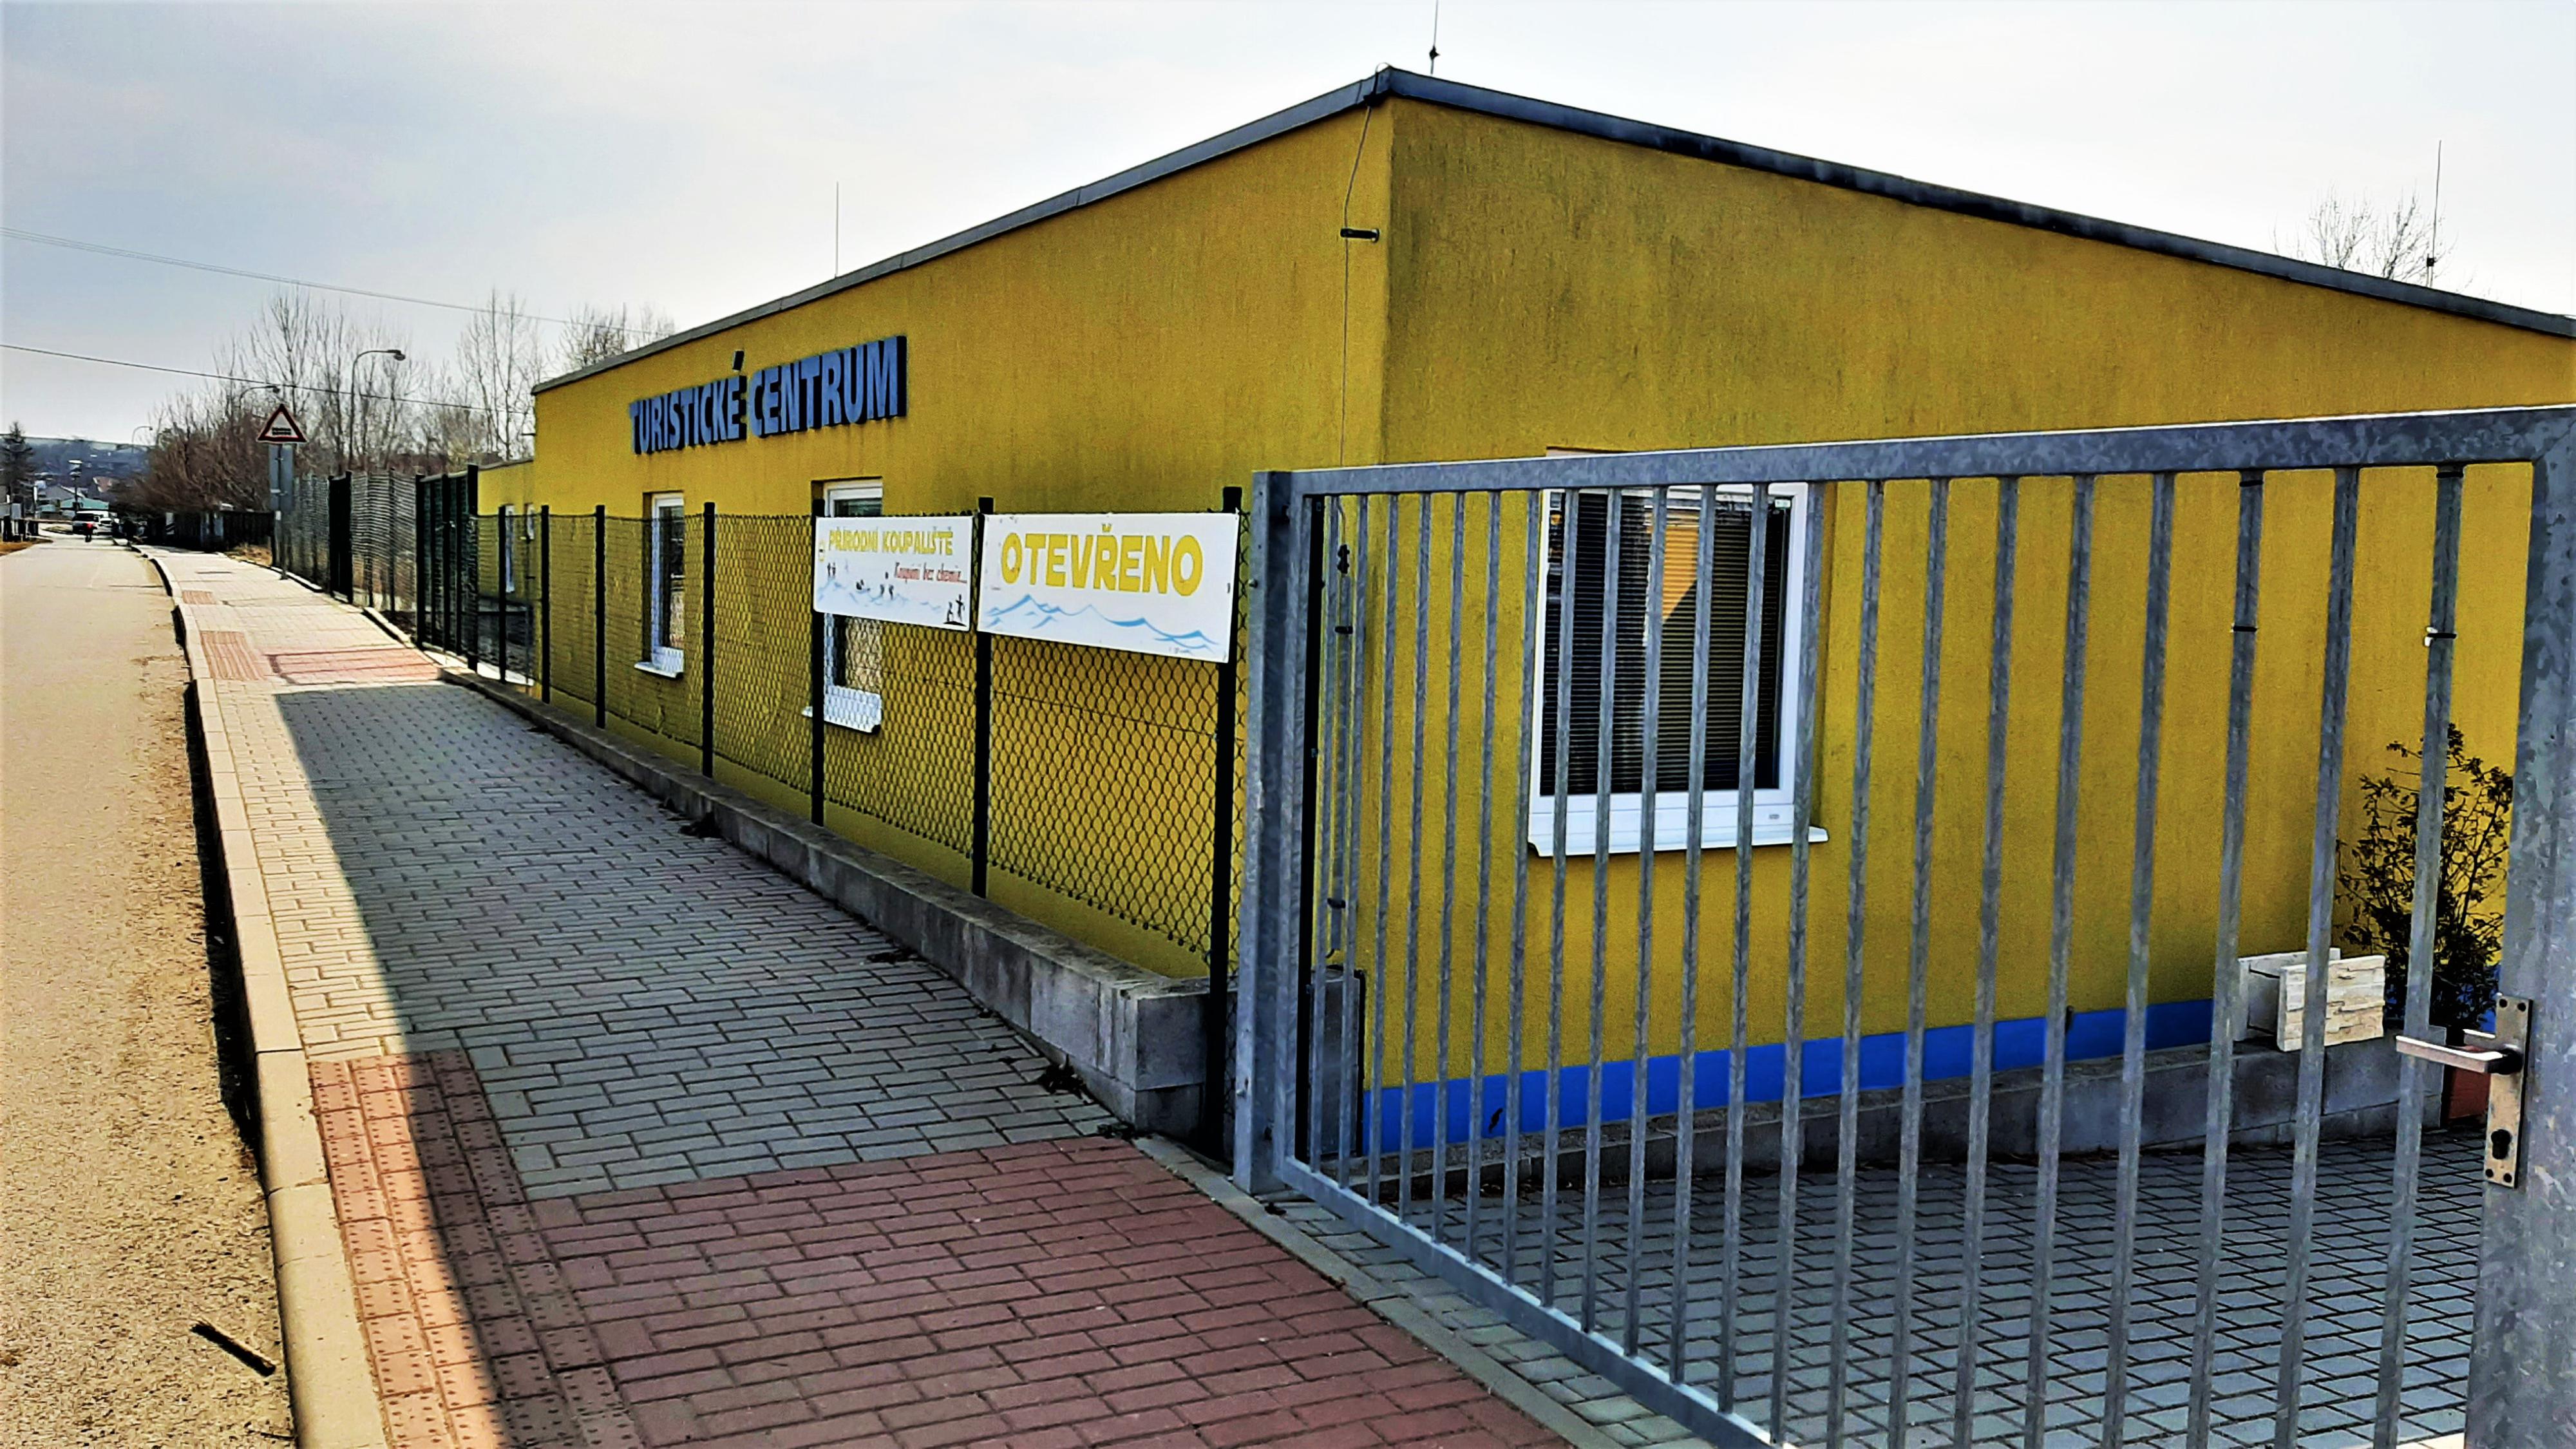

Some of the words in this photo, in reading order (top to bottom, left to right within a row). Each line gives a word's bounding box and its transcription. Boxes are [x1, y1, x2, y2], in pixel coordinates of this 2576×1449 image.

[629, 350, 747, 455] TURISTICKÉ
[748, 335, 907, 439] CENTRUM
[881, 526, 953, 556] KOUPALIŠTĚ
[1001, 522, 1204, 597] OTEVŘENO
